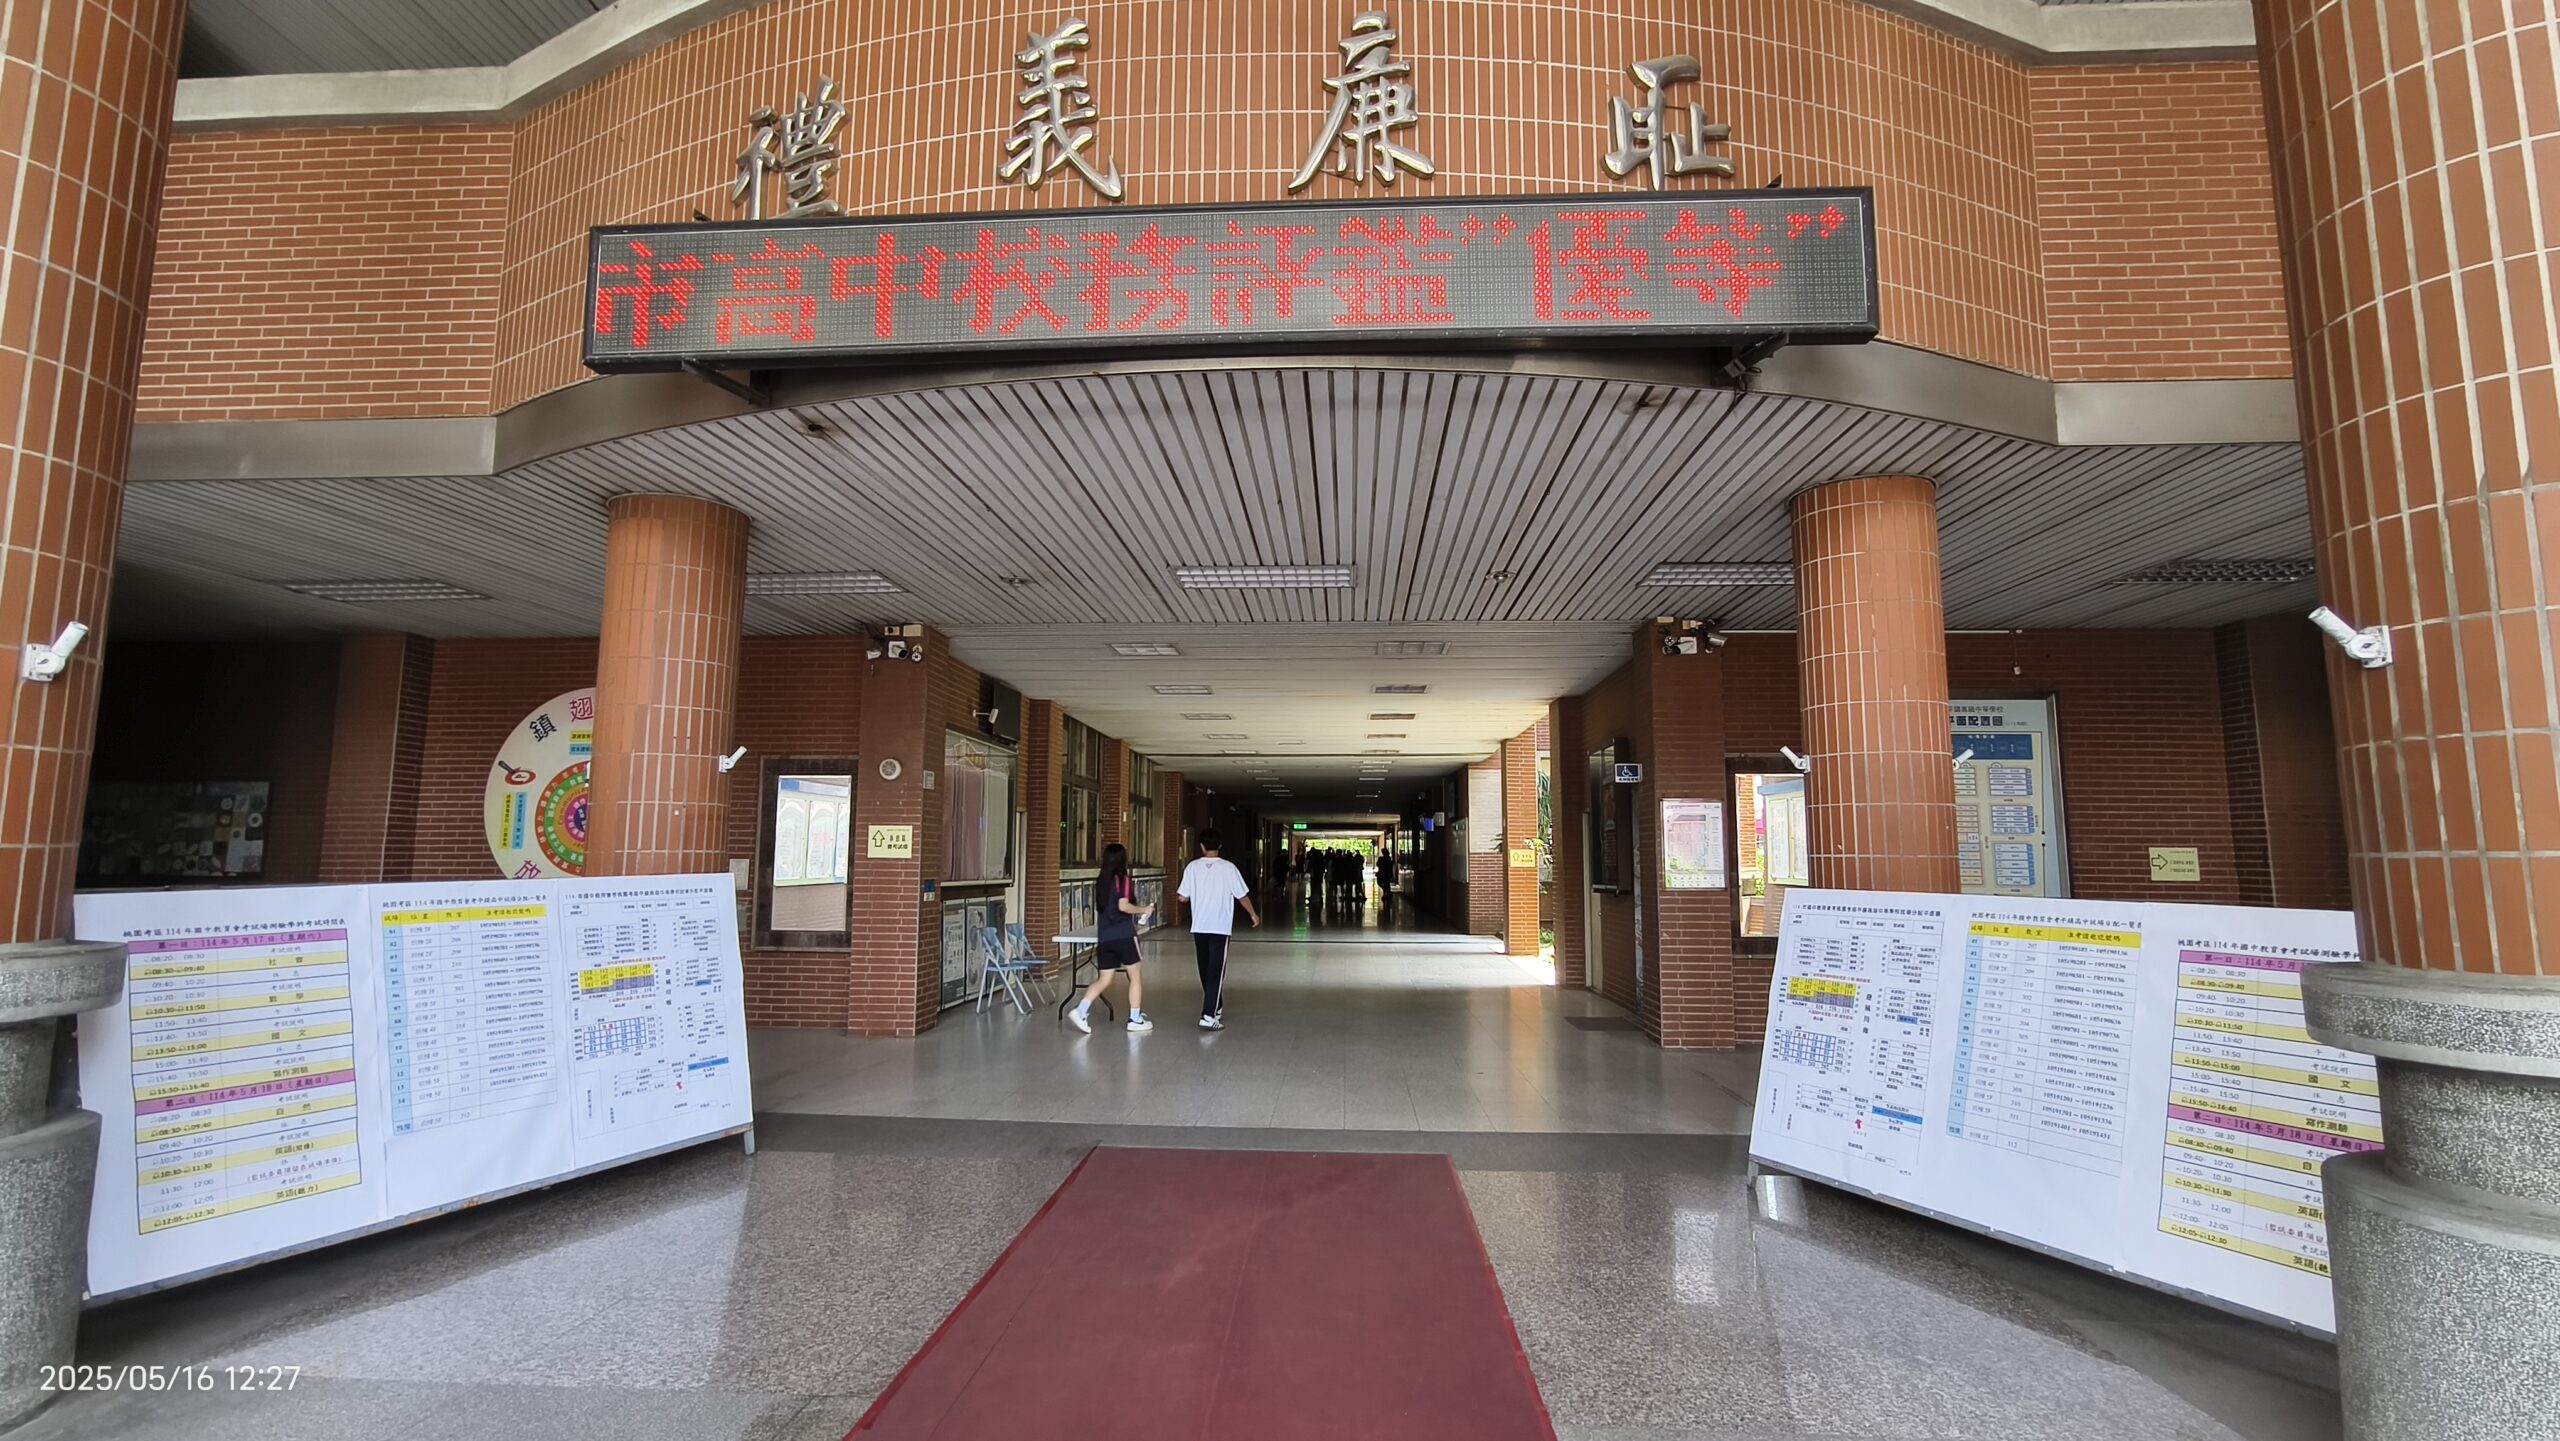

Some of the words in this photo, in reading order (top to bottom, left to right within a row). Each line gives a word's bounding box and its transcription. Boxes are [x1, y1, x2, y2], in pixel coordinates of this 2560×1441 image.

[999, 17, 1128, 199] 義
[1288, 9, 1437, 197] 廉
[731, 74, 848, 221] 禮
[569, 697, 594, 722] 翅
[529, 713, 557, 742] 鎮
[513, 860, 542, 879] 放
[2305, 1117, 2347, 1132] 寫作測驗
